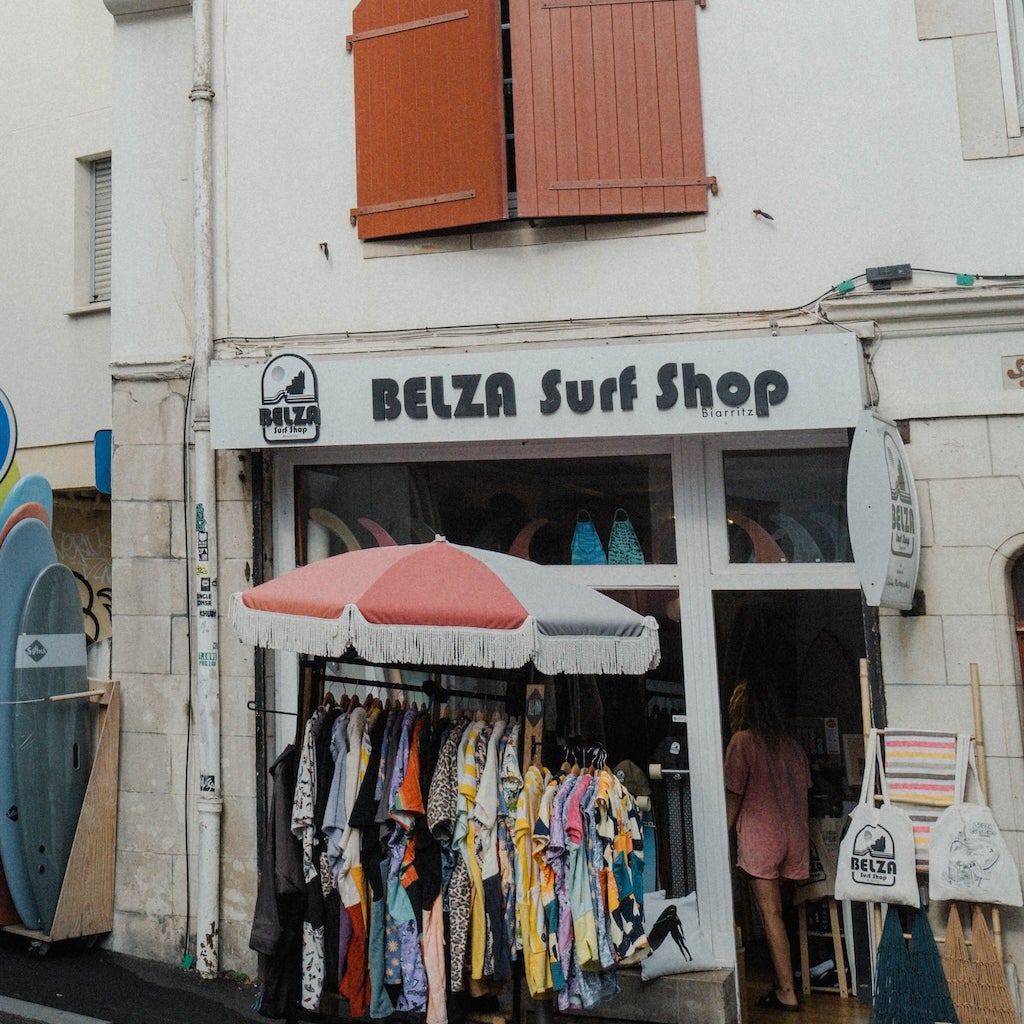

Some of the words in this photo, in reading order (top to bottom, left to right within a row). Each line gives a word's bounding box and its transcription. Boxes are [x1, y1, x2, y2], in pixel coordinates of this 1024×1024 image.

[372, 371, 517, 420] BELZA
[540, 365, 638, 414] Surf
[656, 362, 789, 417] Shop
[259, 406, 321, 426] BELZA
[702, 406, 754, 417] Biarritz
[290, 426, 307, 434] Shop
[891, 503, 915, 534] BELZA
[851, 857, 896, 875] BELZA
